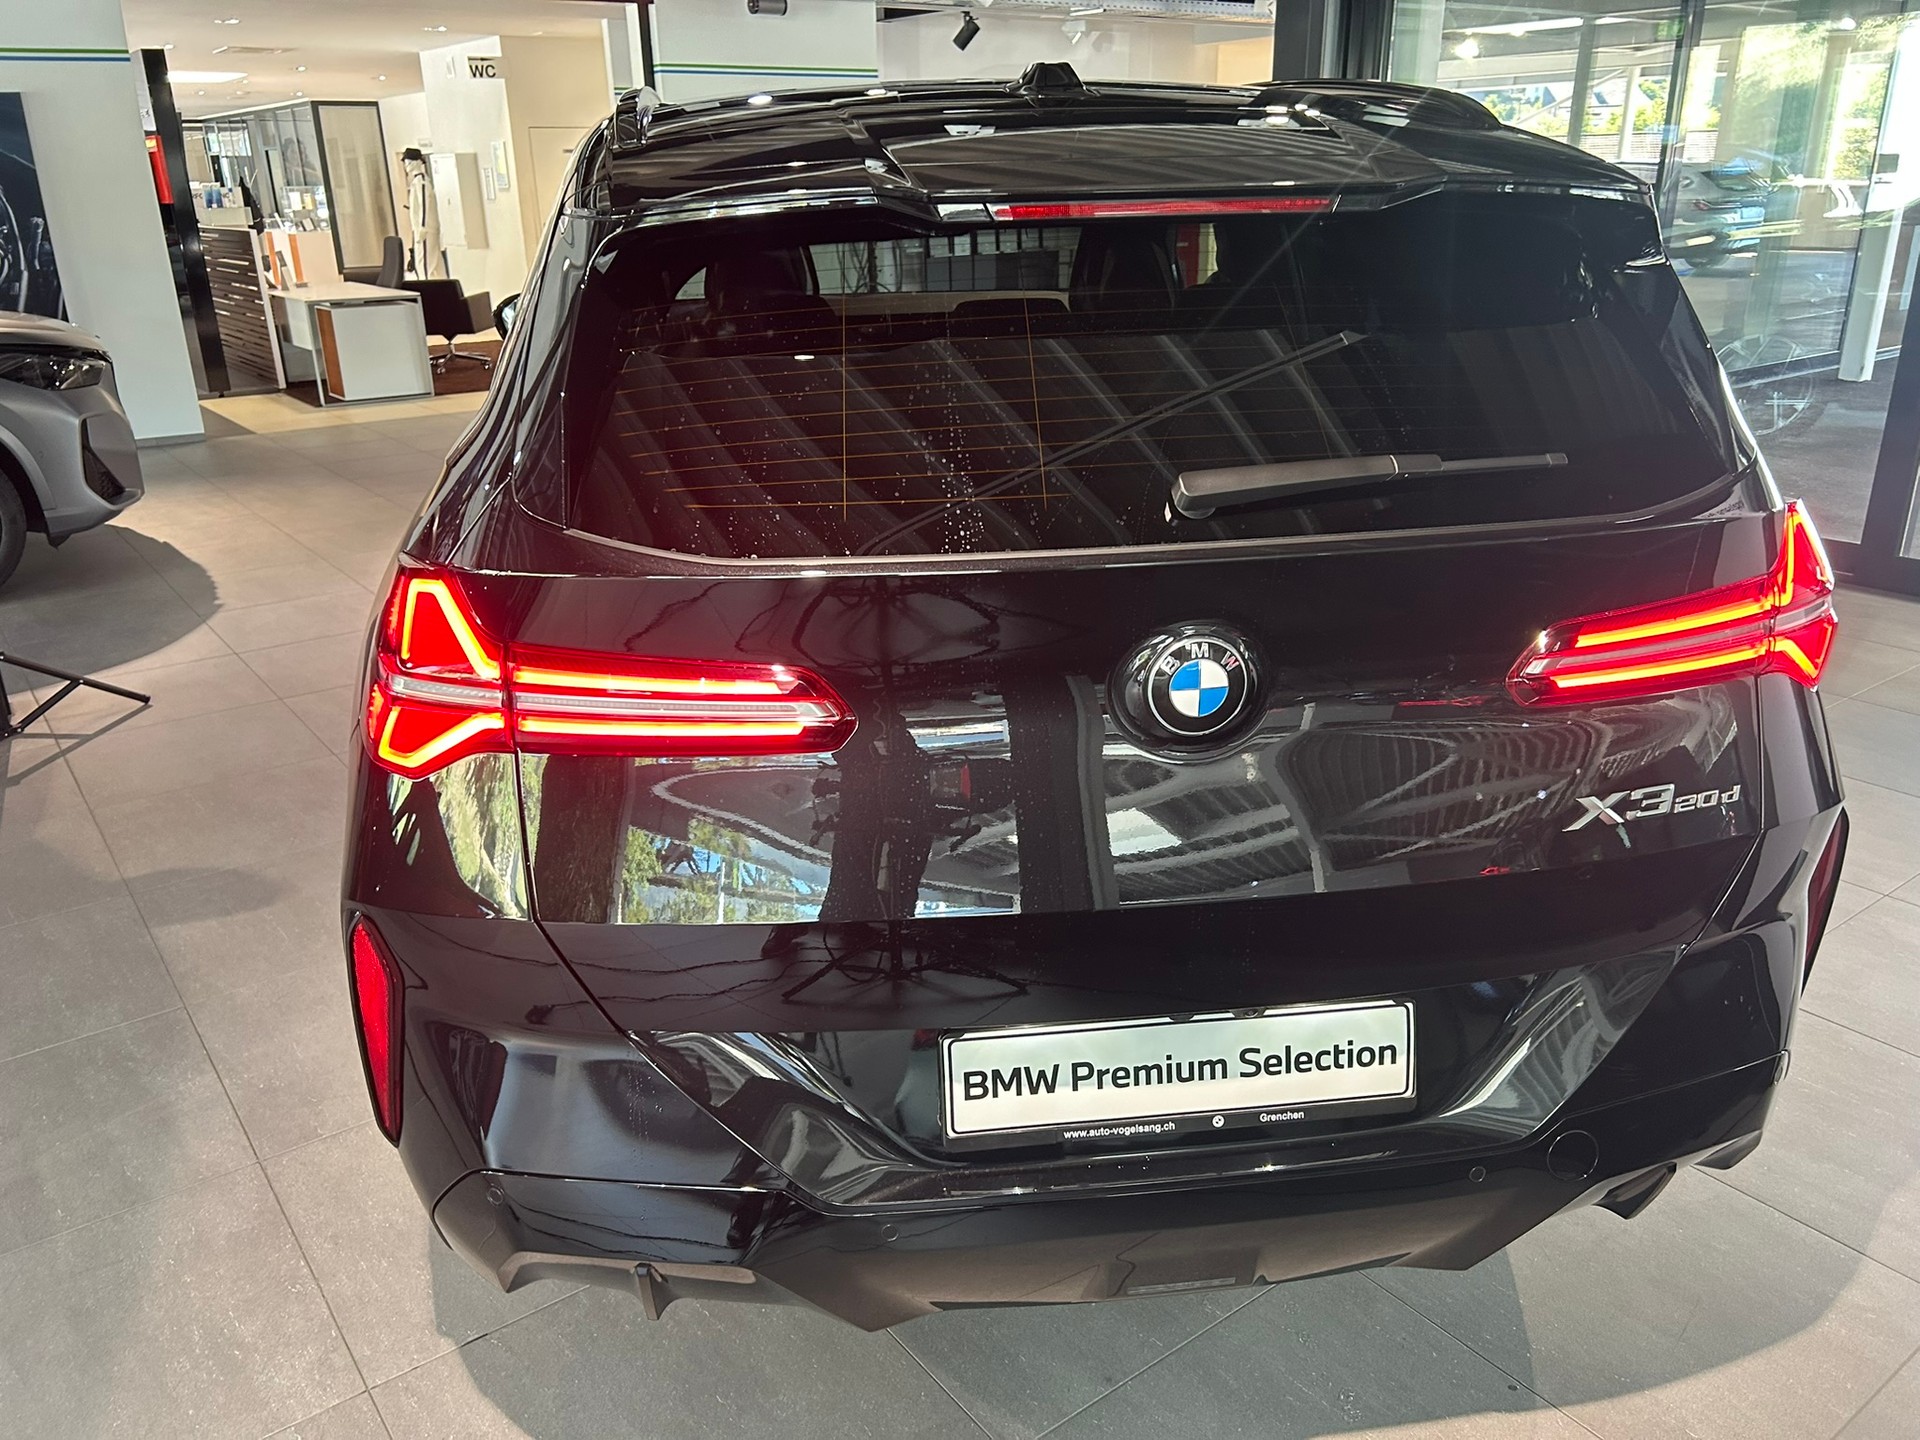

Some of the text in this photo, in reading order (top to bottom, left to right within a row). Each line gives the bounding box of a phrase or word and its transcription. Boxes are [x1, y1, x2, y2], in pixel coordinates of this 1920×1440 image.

[469, 64, 496, 78] WC
[1160, 643, 1240, 676] BMW
[963, 1040, 1398, 1101] BMW Premium Selection
[1259, 1111, 1305, 1123] Grenchen
[1063, 1121, 1176, 1140] www.auto-vogelsang.ch
